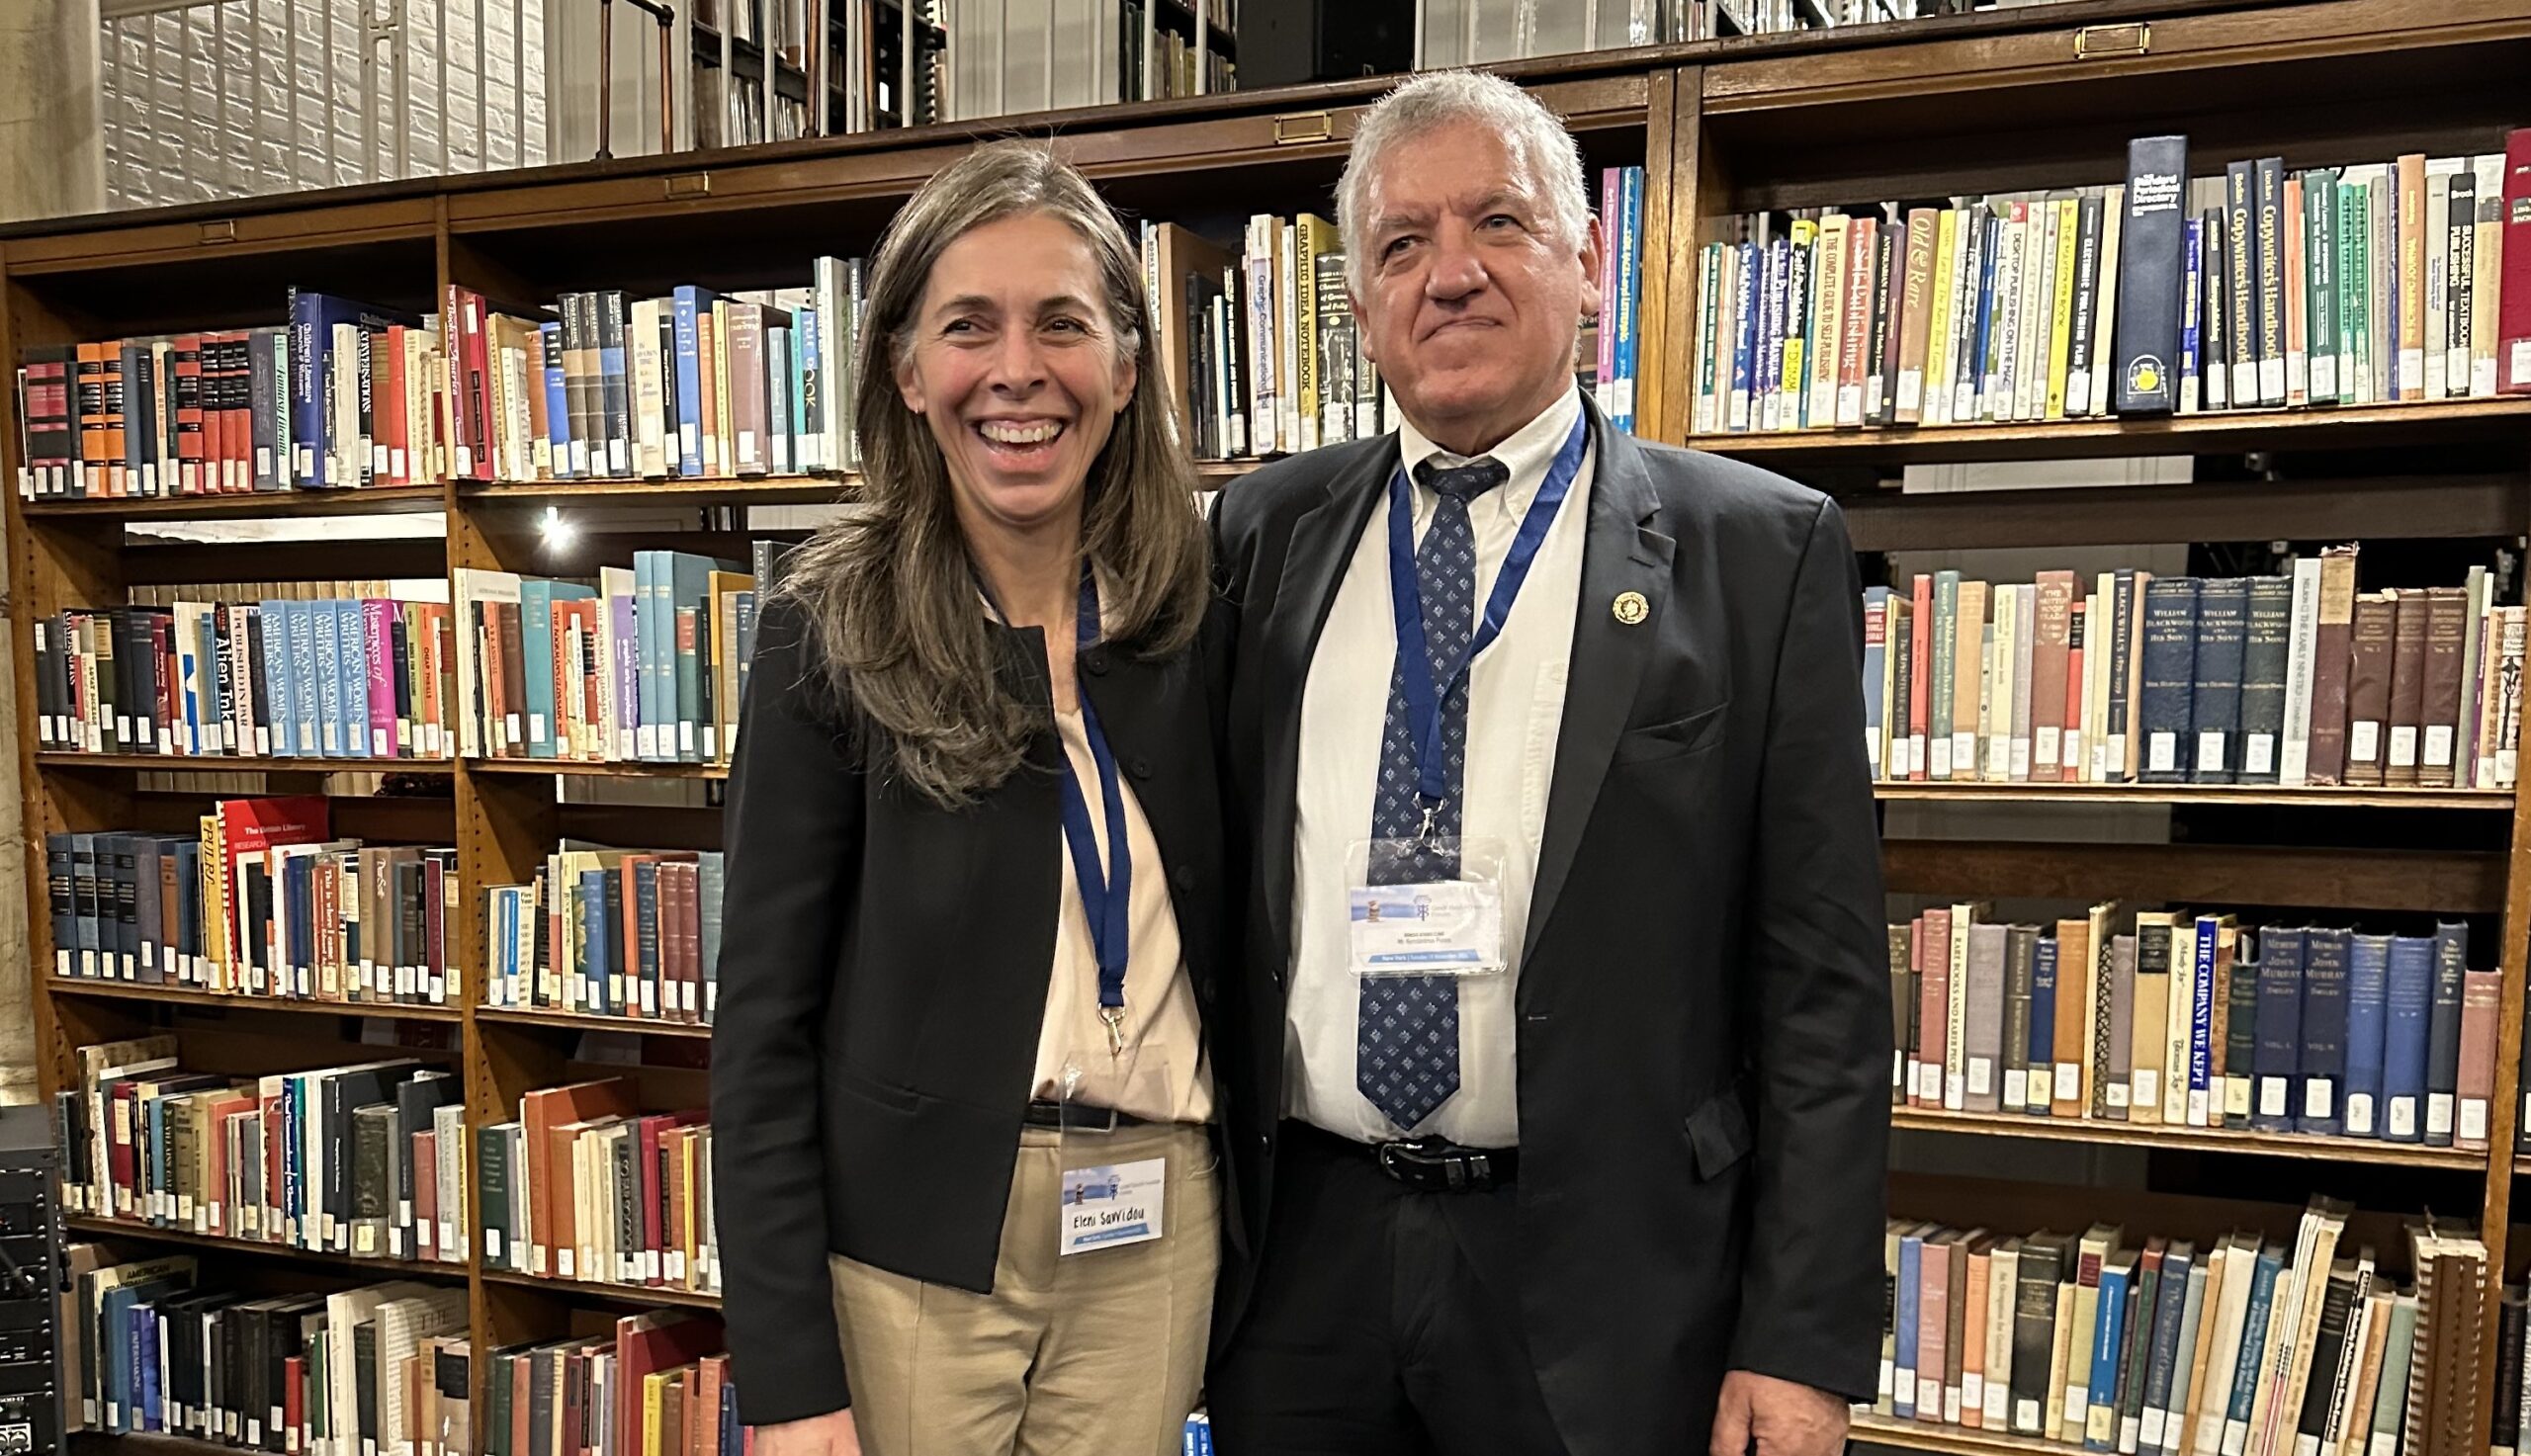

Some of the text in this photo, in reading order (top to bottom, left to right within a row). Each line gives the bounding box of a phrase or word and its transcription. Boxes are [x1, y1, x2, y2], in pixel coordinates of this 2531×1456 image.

[1912, 217, 1931, 246] Old
[1298, 223, 1311, 391] GRAPHIC IDEA NOTEBOOK
[1878, 289, 1887, 314] BOOKS
[1907, 269, 1927, 308] Rare
[450, 342, 460, 395] America
[262, 613, 275, 666] WRITERS
[271, 613, 286, 674] AMERICAN
[290, 613, 302, 666] WRITERS
[298, 613, 313, 675] AMERICAN
[314, 614, 326, 667] WRITERS
[321, 614, 335, 675] AMERICAN
[340, 613, 351, 665] WRITERS
[348, 613, 362, 674] AMERICAN
[216, 638, 235, 720] Alien Ink
[372, 666, 387, 687] of
[2192, 933, 2212, 1085] THE COMPANY WE KEPT
